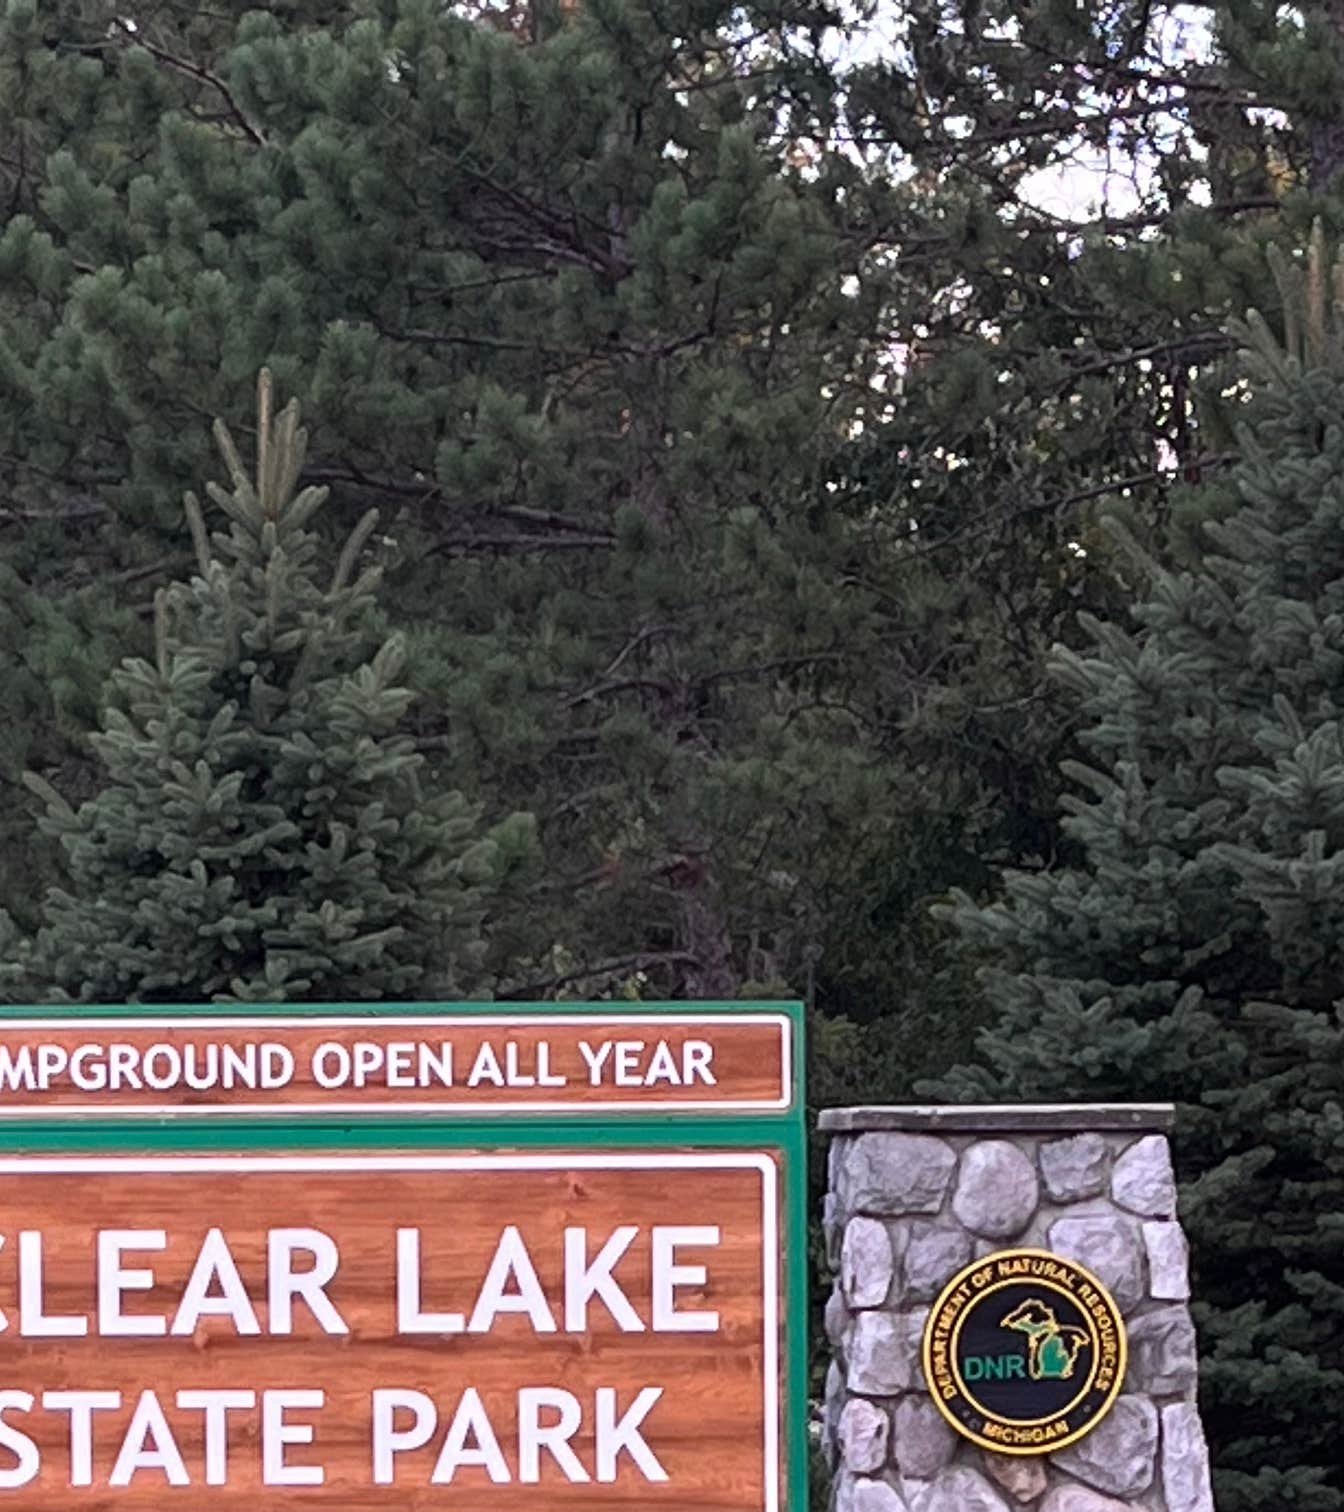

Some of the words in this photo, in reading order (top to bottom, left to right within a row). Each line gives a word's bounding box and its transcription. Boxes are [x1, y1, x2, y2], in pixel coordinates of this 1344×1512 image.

[311, 1042, 453, 1088] OPEN
[468, 1041, 566, 1087] ALL
[578, 1040, 717, 1086] YEAR
[396, 1225, 720, 1335] LAKE
[932, 1285, 972, 1400] DEPARTMENT
[971, 1267, 994, 1289] OF
[997, 1257, 1076, 1289] NATURAL
[1076, 1281, 1118, 1392] RESOURCES
[963, 1354, 1026, 1381] DNR
[371, 1387, 670, 1486] PARK
[981, 1419, 1070, 1443] MICHIGAN
